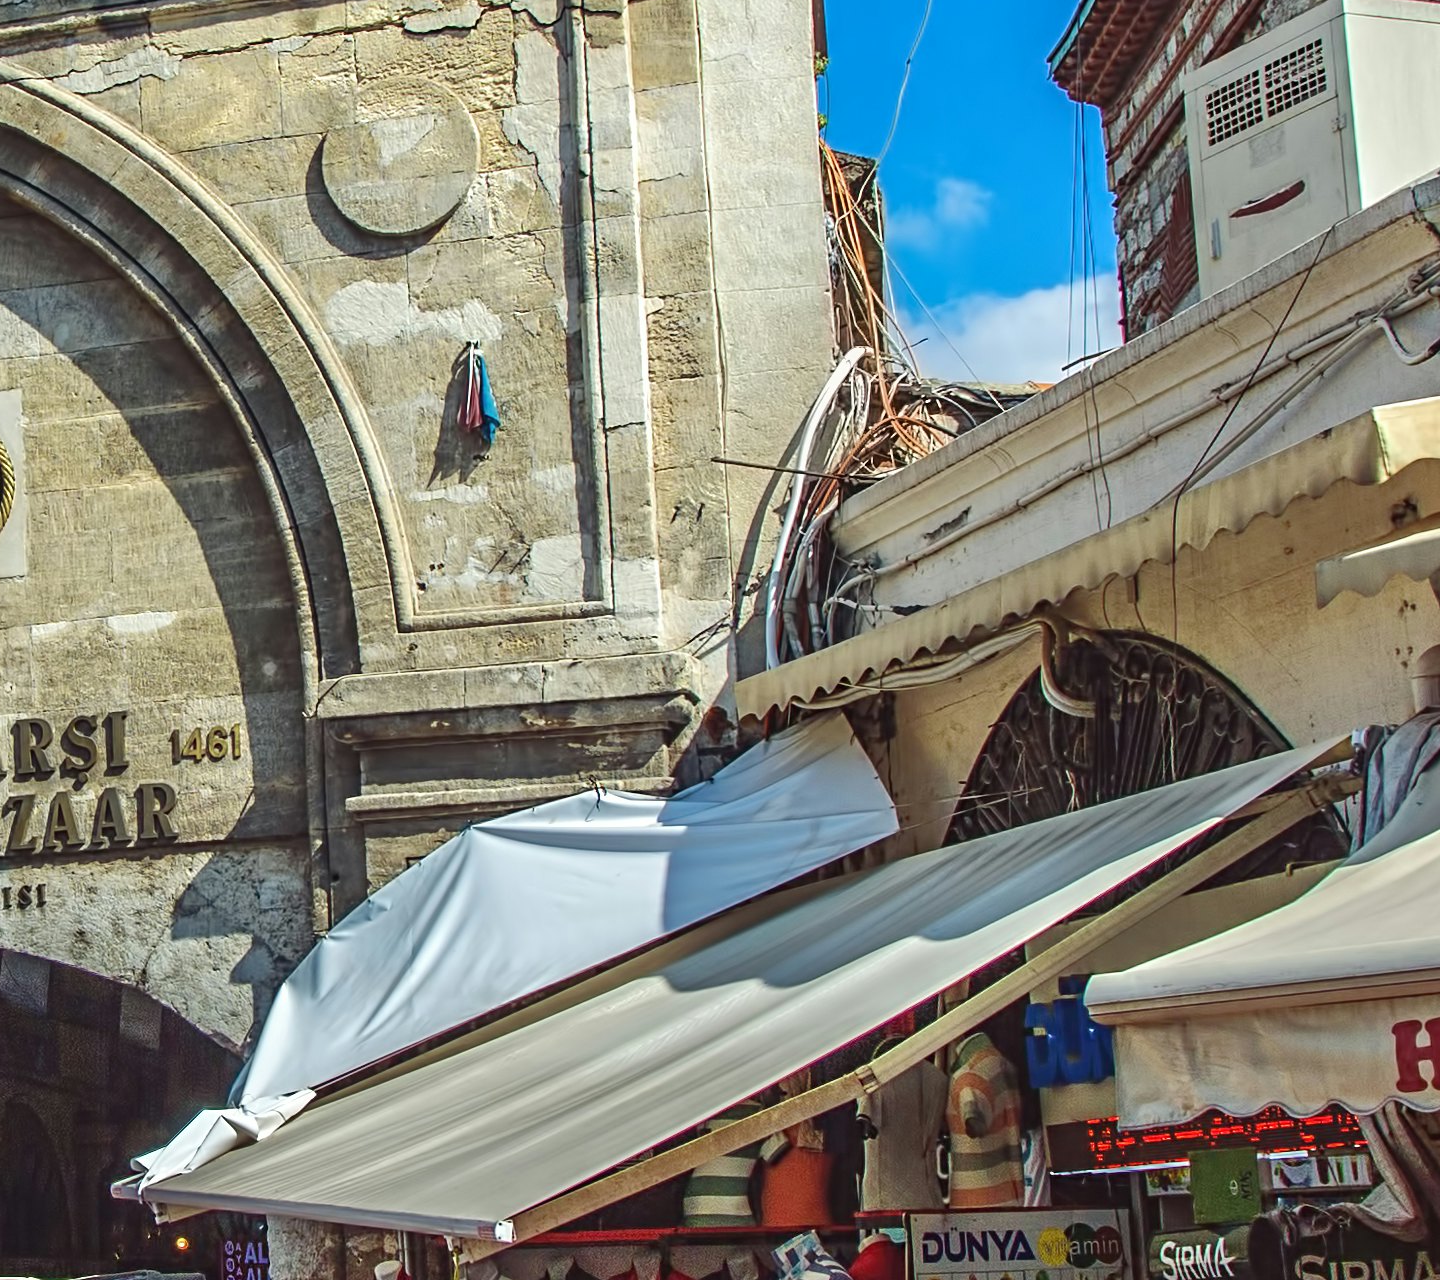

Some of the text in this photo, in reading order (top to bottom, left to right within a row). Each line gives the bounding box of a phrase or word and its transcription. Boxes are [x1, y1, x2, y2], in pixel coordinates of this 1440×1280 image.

[170, 723, 242, 764] 1461
[922, 1226, 1120, 1264] DÜNYA vitamin
